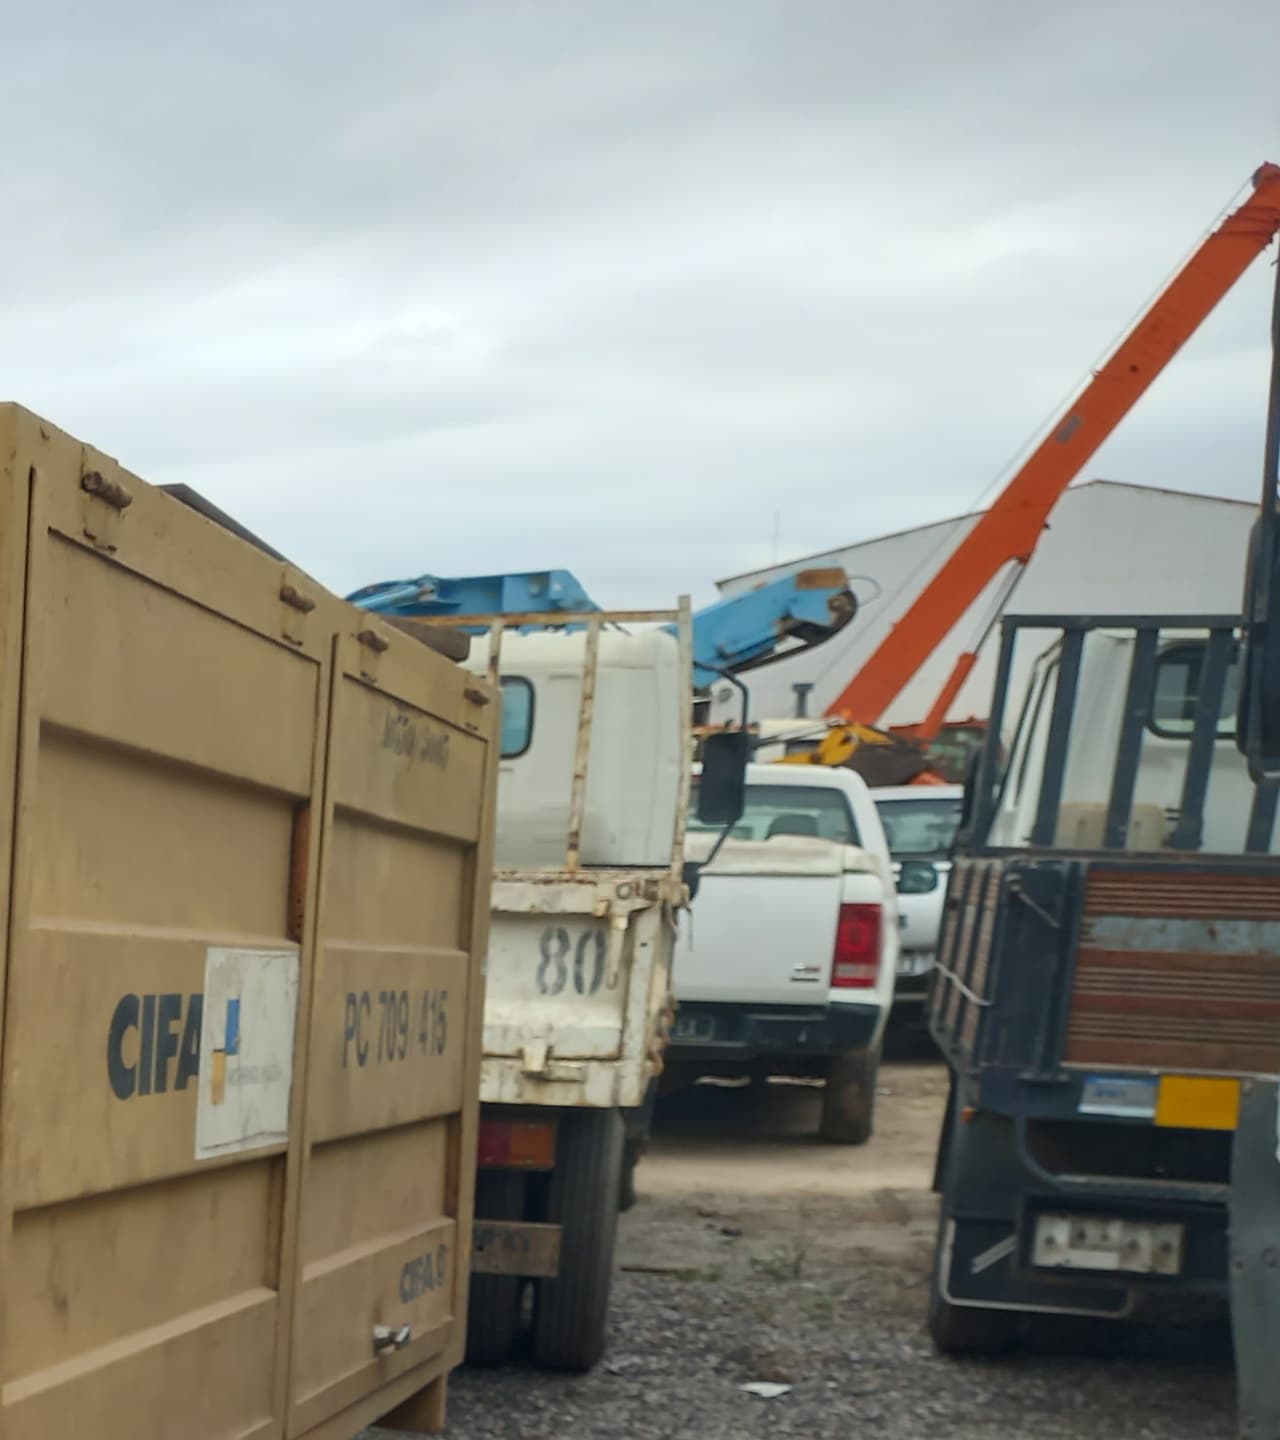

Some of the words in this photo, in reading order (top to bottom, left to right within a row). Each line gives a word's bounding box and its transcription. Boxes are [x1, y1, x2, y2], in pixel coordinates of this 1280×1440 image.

[537, 927, 606, 996] 80
[107, 993, 204, 1100] CIFA
[342, 991, 371, 1069] PC
